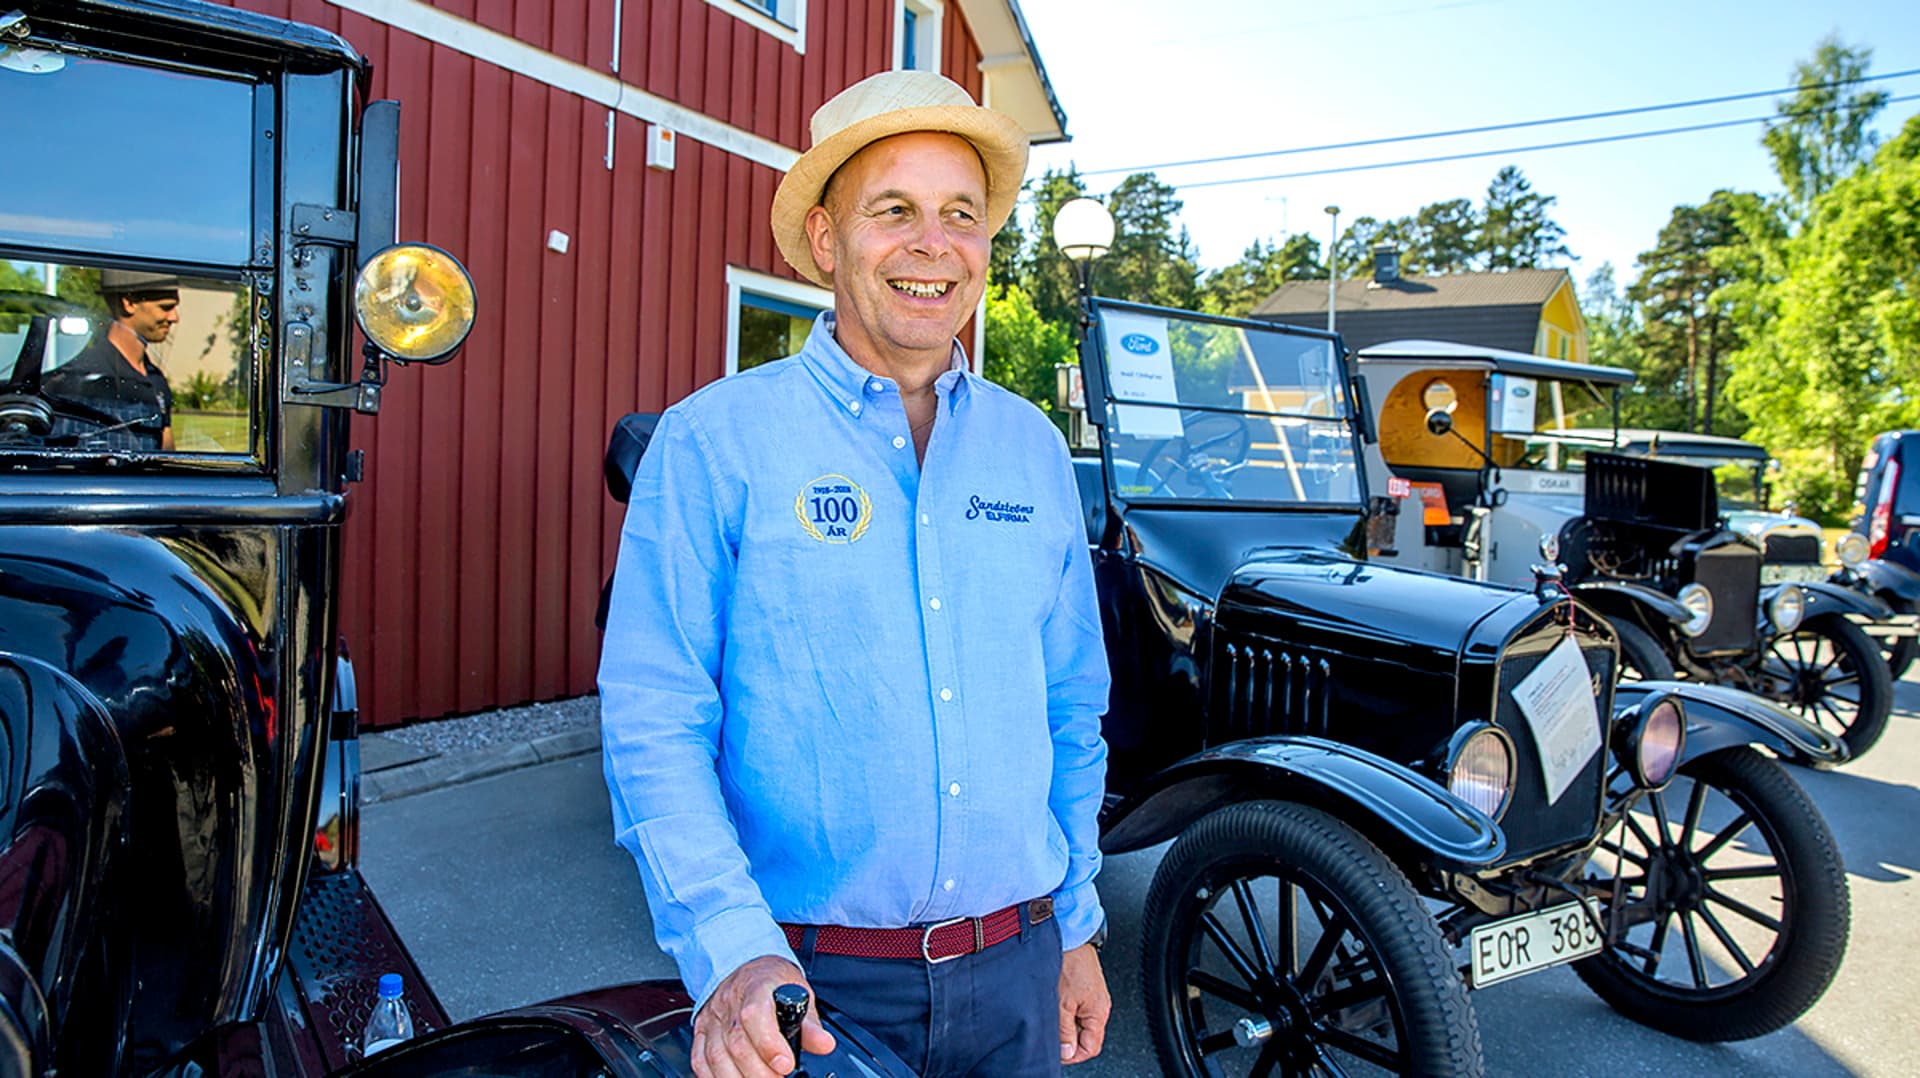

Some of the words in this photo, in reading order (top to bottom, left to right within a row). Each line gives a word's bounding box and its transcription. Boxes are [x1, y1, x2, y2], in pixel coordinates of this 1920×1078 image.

[1127, 336, 1153, 353] Ford
[1539, 478, 1571, 489] OSKAR
[810, 497, 858, 523] 100
[827, 524, 847, 537] ÅR
[1479, 926, 1532, 976] EOR
